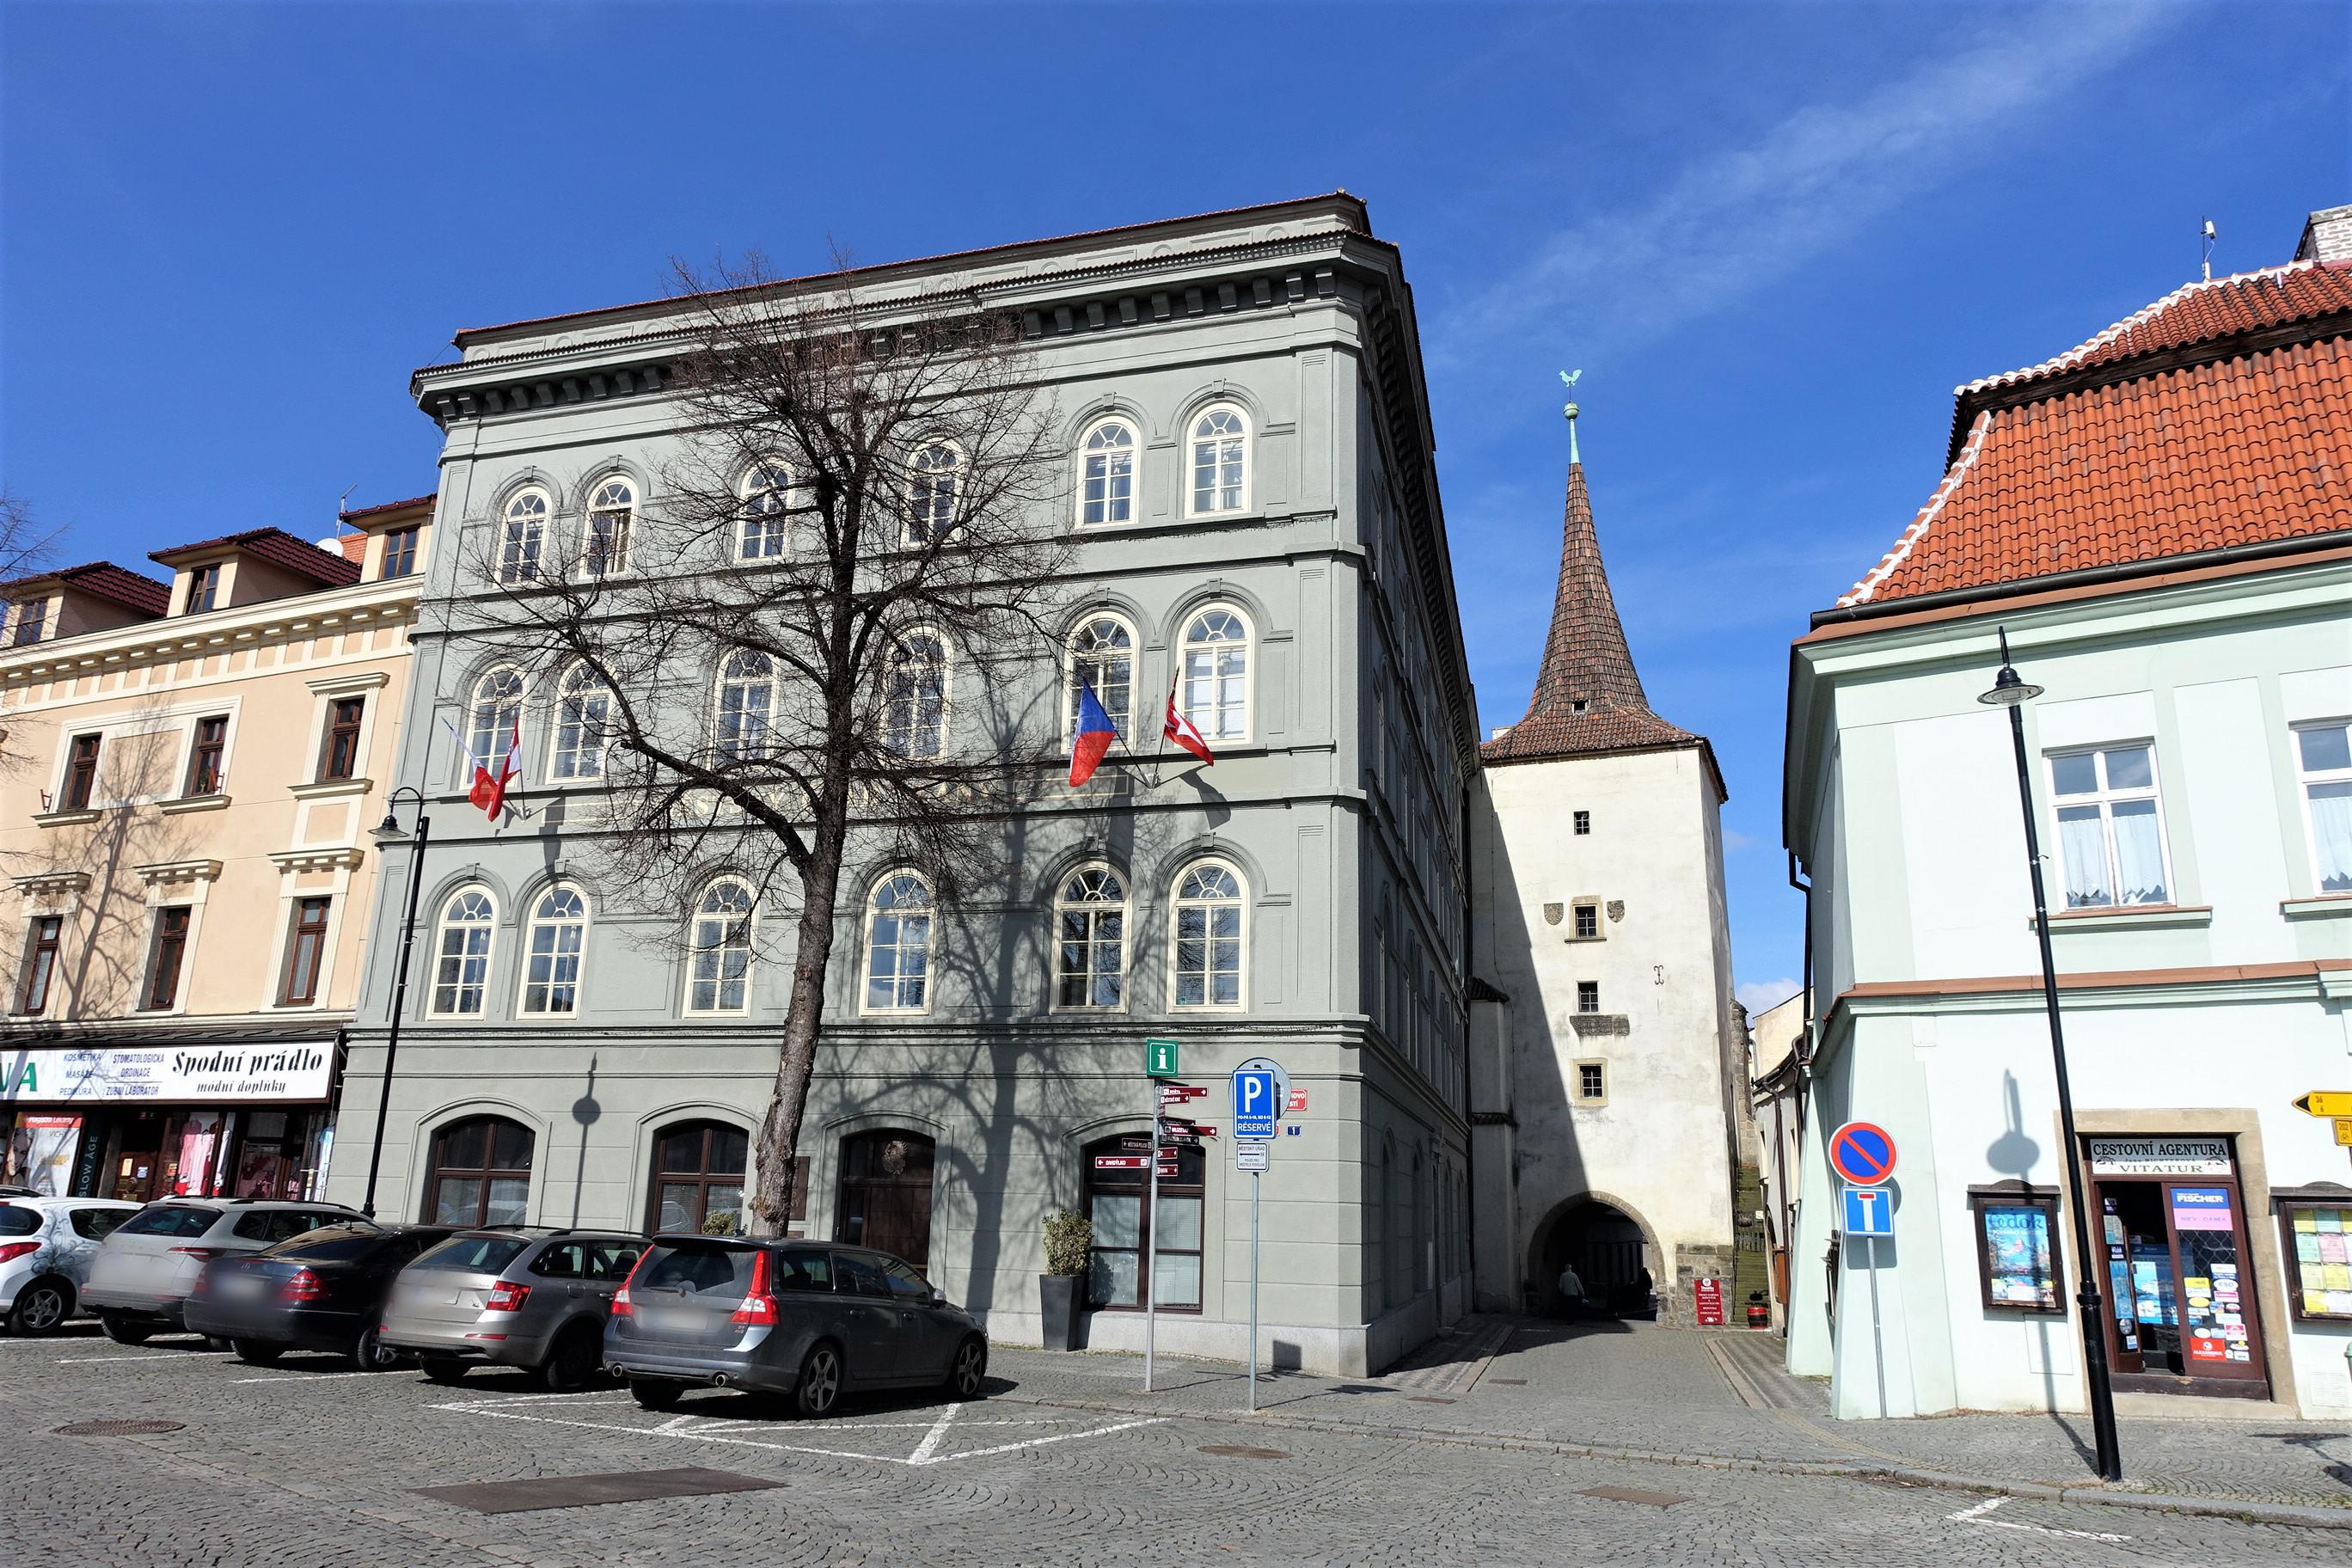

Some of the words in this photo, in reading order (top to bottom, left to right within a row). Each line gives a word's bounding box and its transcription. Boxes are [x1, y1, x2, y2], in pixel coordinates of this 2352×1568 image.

[172, 1050, 246, 1076] Spodní
[249, 1049, 323, 1075] prádlo
[1244, 1076, 1262, 1113] P
[1237, 1121, 1271, 1132] RÉSERVÉ
[2093, 1141, 2153, 1155] CESTOVNÍ
[2159, 1144, 2226, 1155] AGENTURA
[2120, 1165, 2203, 1173] VITATUR
[79, 1164, 93, 1197] SLOW
[2177, 1195, 2224, 1204] FISCHER
